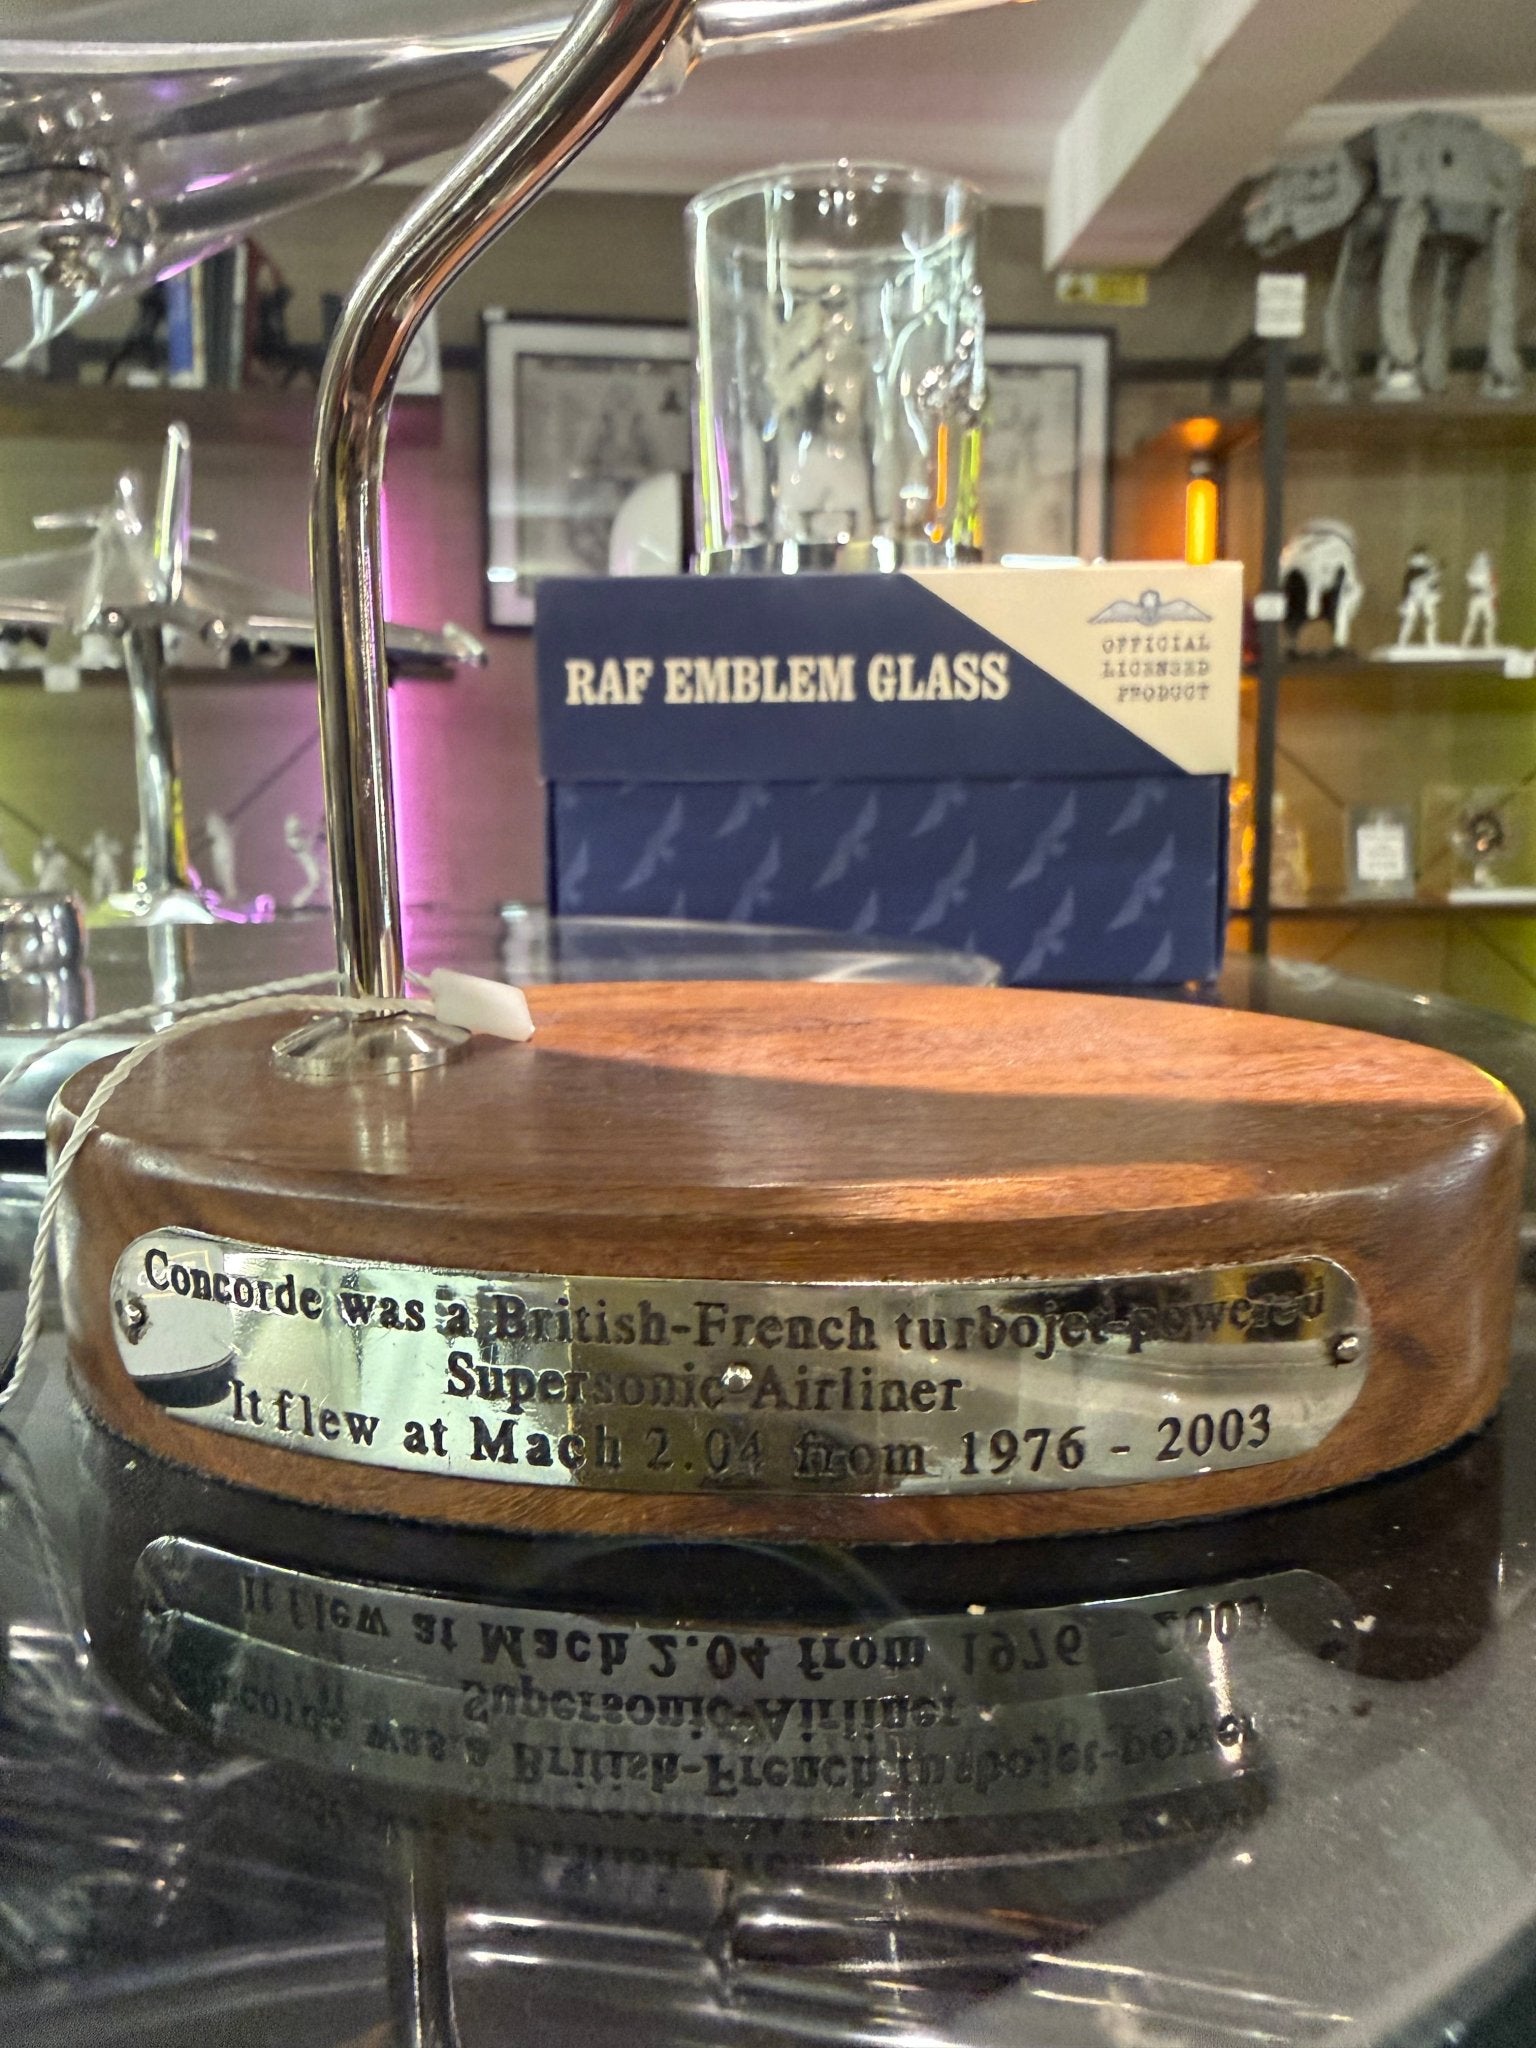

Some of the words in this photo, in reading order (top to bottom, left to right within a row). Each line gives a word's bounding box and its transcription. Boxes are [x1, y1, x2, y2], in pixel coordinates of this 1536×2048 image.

[1102, 634, 1211, 654] OFFICIAL
[565, 658, 653, 706] RAF
[664, 655, 855, 705] EMBLEM
[868, 652, 1010, 702] GLASS
[1102, 659, 1210, 679] LICENSED
[1118, 683, 1210, 702] PRODUCT
[144, 1248, 323, 1319] Concorde
[340, 1290, 426, 1332] was
[446, 1302, 473, 1337] a
[493, 1293, 880, 1351] British-French
[231, 1379, 265, 1426] It
[272, 1388, 381, 1447] flew
[403, 1418, 449, 1458] at
[470, 1416, 622, 1472] Mach
[646, 1426, 764, 1474] 2.04
[794, 1430, 926, 1478] from
[960, 1425, 1086, 1475] 1976
[1156, 1403, 1271, 1462] 2003
